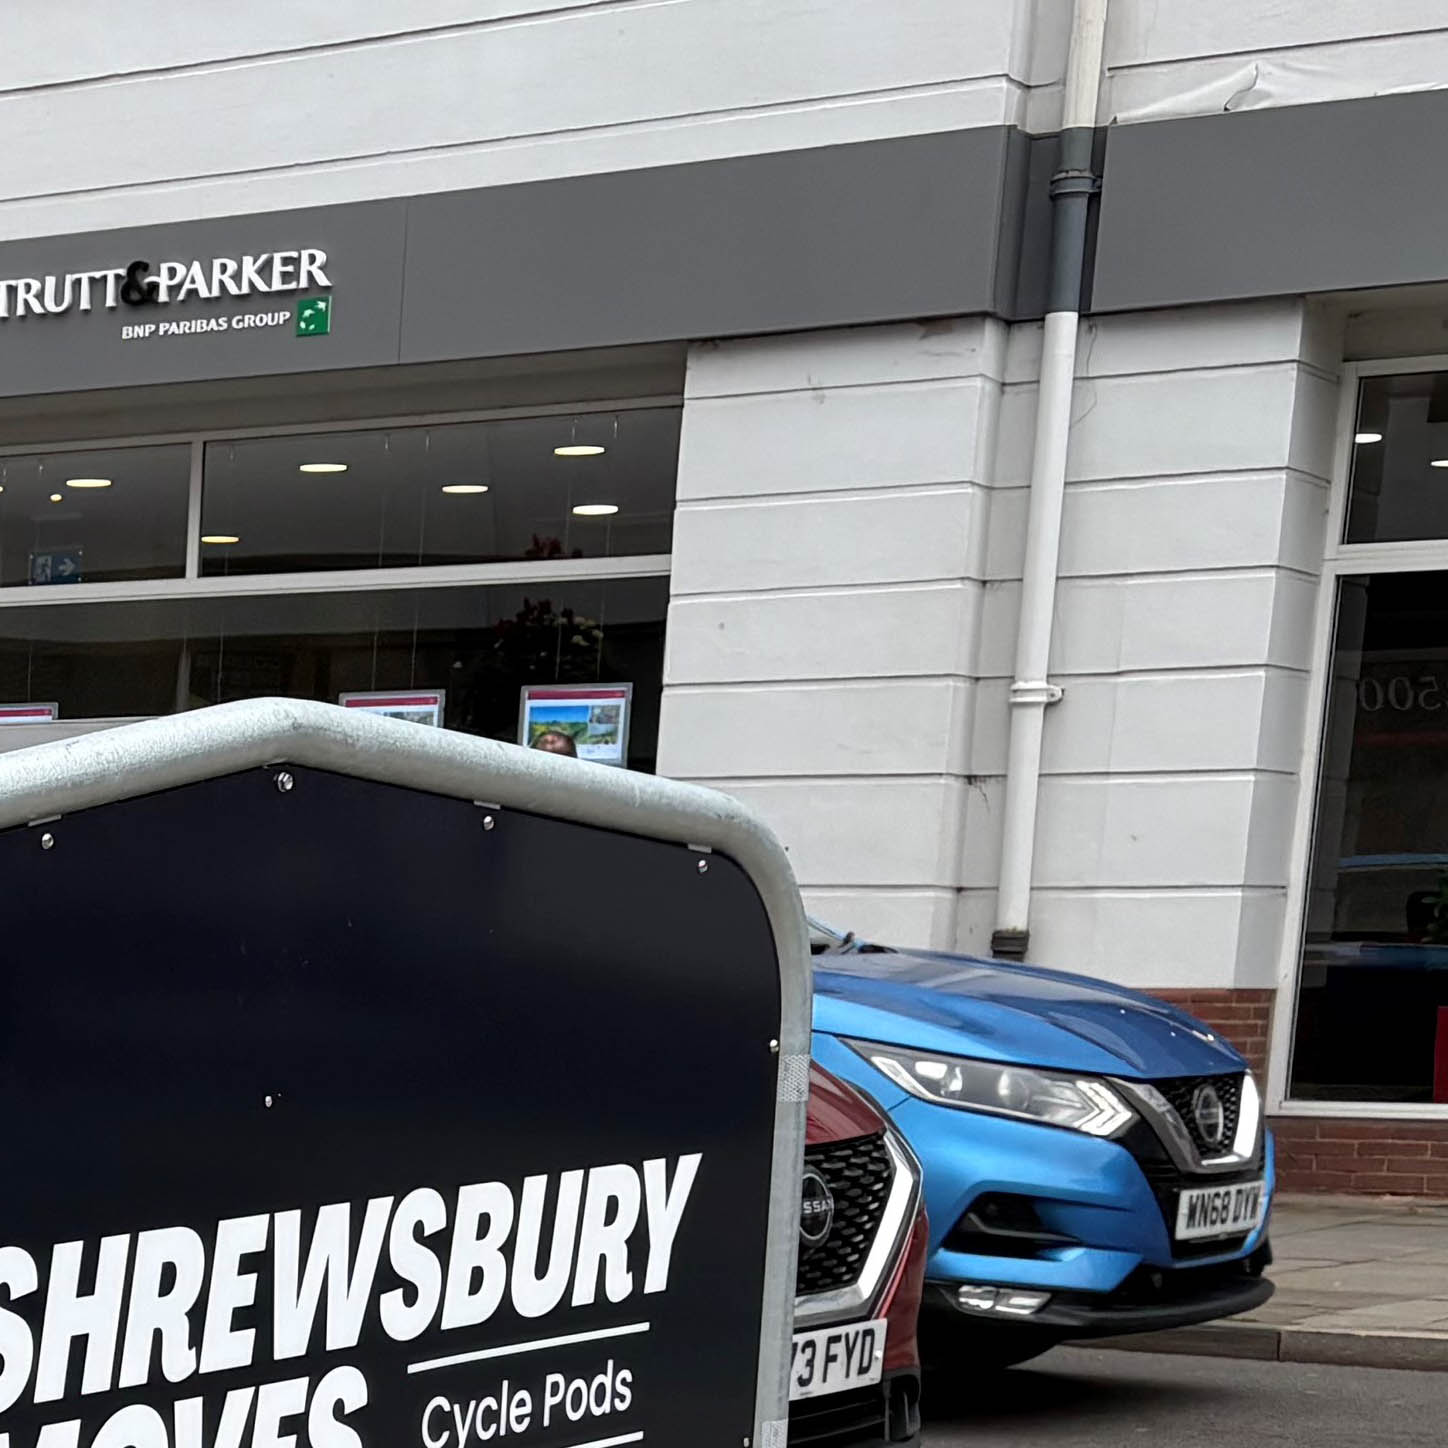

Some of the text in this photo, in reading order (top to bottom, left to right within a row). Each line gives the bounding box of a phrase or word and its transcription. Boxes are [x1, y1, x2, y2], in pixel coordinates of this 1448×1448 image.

[122, 310, 291, 340] BNP PARIBAS GROUP
[822, 1328, 876, 1383] FYD
[543, 1359, 634, 1430] Pods
